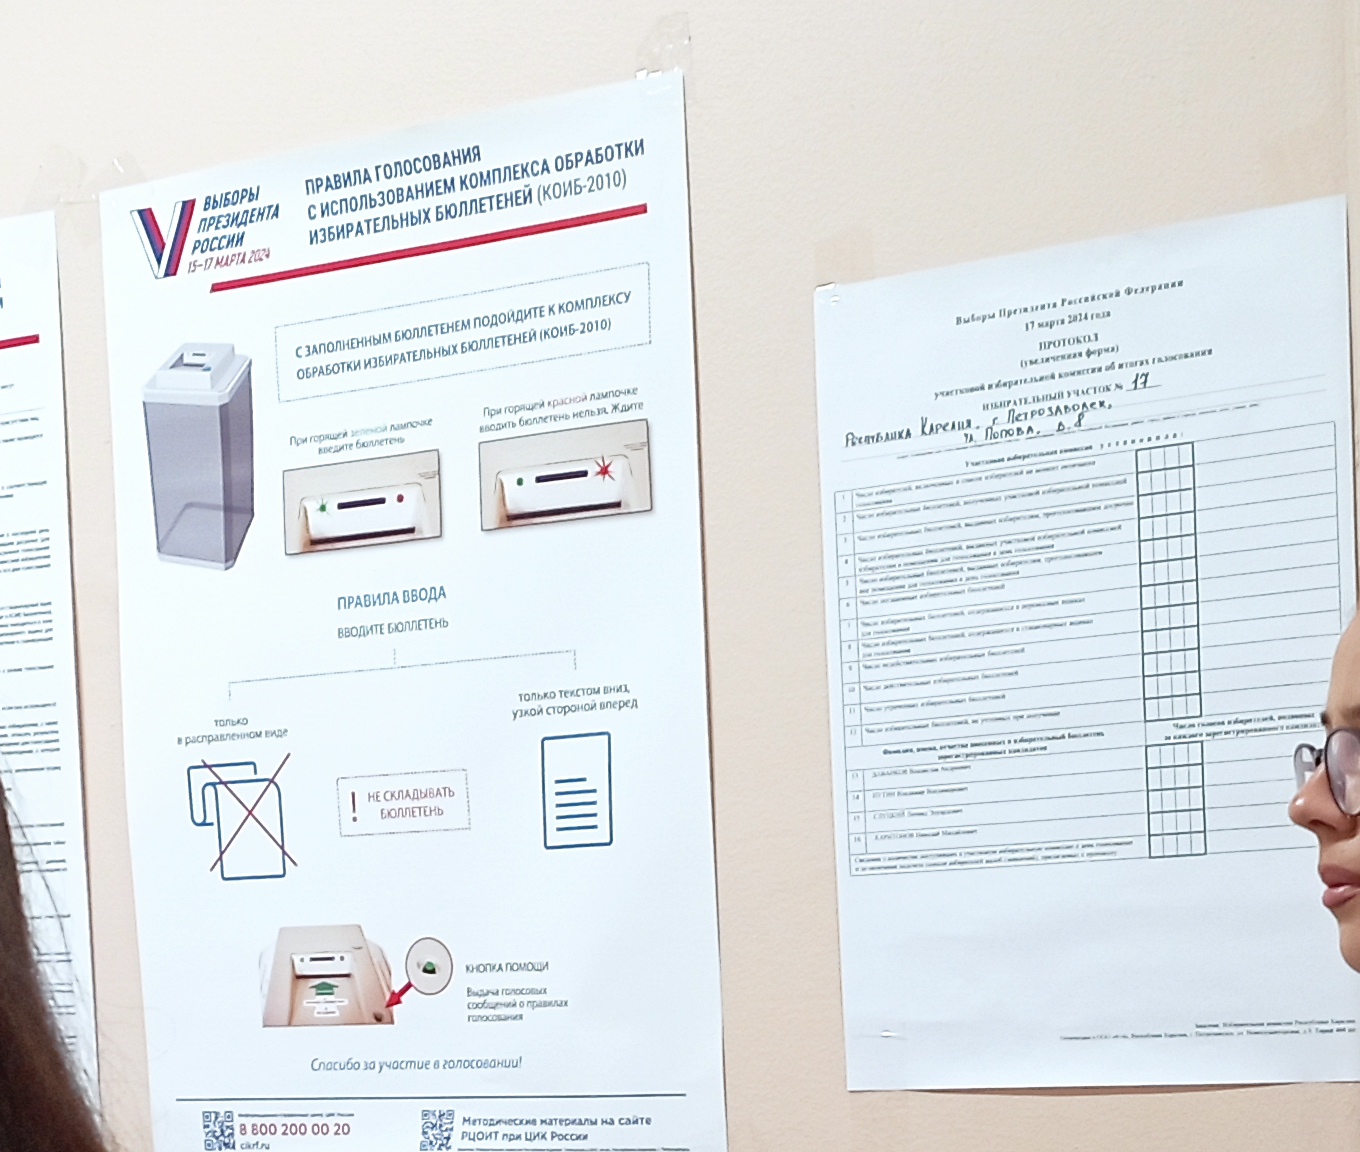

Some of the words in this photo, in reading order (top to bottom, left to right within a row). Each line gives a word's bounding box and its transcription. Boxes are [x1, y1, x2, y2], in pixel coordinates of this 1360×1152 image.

[304, 167, 373, 196] ПРАВИЛА
[374, 144, 482, 182] ГОЛОСОВАНИЯ
[307, 203, 317, 221] С
[319, 175, 456, 219] ИСПОЛЬЗОВАНИЕМ
[458, 157, 551, 192] КОМПЛЕКСА
[554, 138, 645, 173] ОБРАБОТКИ
[202, 184, 261, 212] ВЫБОРЫ
[308, 206, 432, 246] ИЗБИРАТЕЛЬНЫХ
[434, 187, 533, 222] БЮЛЛЕТЕНЕЙ
[536, 169, 627, 207] (КОИБ-2010)
[196, 202, 280, 234] ПРЕЗИДЕНТА
[190, 230, 246, 256] РОССИИ
[214, 251, 246, 269] МАРТА
[248, 247, 271, 264] 2024
[294, 345, 303, 359] С
[304, 331, 392, 358] ЗАПОЛНЕННЫМ
[393, 317, 471, 343] БЮЛЛЕТЕНЕМ
[472, 304, 546, 330] ПОДОЙДИТЕ
[547, 303, 556, 317] К
[557, 290, 632, 315] КОМПЛЕКСУ
[1024, 319, 1035, 332] 17
[1067, 311, 1089, 325] 2024
[295, 358, 362, 381] ОБРАБОТКИ
[362, 342, 459, 370] ИЗБИРАТЕЛЬНЫХ
[459, 327, 537, 355] БЮЛЛЕТЕНЕЙ
[538, 317, 612, 342] (КОИБ-2010)
[1038, 332, 1099, 352] ПРОТОКОЛ
[1131, 371, 1150, 391] 17
[482, 405, 502, 419] При
[503, 399, 545, 416] горящей
[546, 393, 588, 410] красной
[588, 386, 639, 402] лампочке
[478, 420, 517, 434] вводить
[517, 412, 571, 428] бюллетень
[610, 401, 644, 414] Ждите
[288, 434, 308, 447] При
[308, 428, 348, 444] горящей
[389, 417, 433, 432] лампочке
[317, 442, 354, 456] введите
[354, 435, 406, 450] бюллетень
[336, 590, 400, 611] ПРАВИЛА
[401, 585, 447, 604] ВВОДА
[337, 622, 385, 639] ВВОДИТЕ
[386, 616, 449, 635] БЮЛЛЕТЕНЬ
[517, 690, 557, 703] только
[557, 686, 601, 699] текстом
[511, 704, 544, 722] узкой
[545, 699, 597, 717] стороной
[598, 697, 639, 712] вперед
[213, 716, 249, 728] только
[184, 729, 263, 748] расправленном
[263, 727, 289, 739] виде
[367, 790, 381, 803] НЕ
[382, 785, 456, 802] СКЛАДЫВАТЬ
[379, 804, 444, 820] БЮЛЛЕТЕНЬ
[464, 962, 504, 974] КНОПКА
[504, 960, 549, 973] ПОМОЩИ
[466, 986, 500, 999] Выдача
[500, 986, 548, 996] голосовых
[466, 998, 518, 1011] сообщений
[518, 999, 525, 1009] о
[525, 999, 569, 1011] правилах
[466, 1012, 524, 1023] голосования
[310, 1056, 361, 1072] Спасибо
[362, 1059, 376, 1071] за
[377, 1059, 431, 1074] участие
[432, 1059, 440, 1070] в
[441, 1055, 523, 1070] голосовании!
[238, 1122, 247, 1136] 8
[250, 1122, 278, 1136] 800
[280, 1122, 308, 1136] 200
[310, 1122, 330, 1136] 00
[332, 1122, 351, 1136] 20
[461, 1115, 538, 1127] Методические
[539, 1117, 598, 1127] материалы
[600, 1116, 615, 1126] на
[617, 1114, 652, 1126] сайте
[460, 1130, 500, 1143] РЦОИТ
[501, 1132, 522, 1143] при
[524, 1130, 548, 1143] ЦИК
[549, 1130, 589, 1142] России
